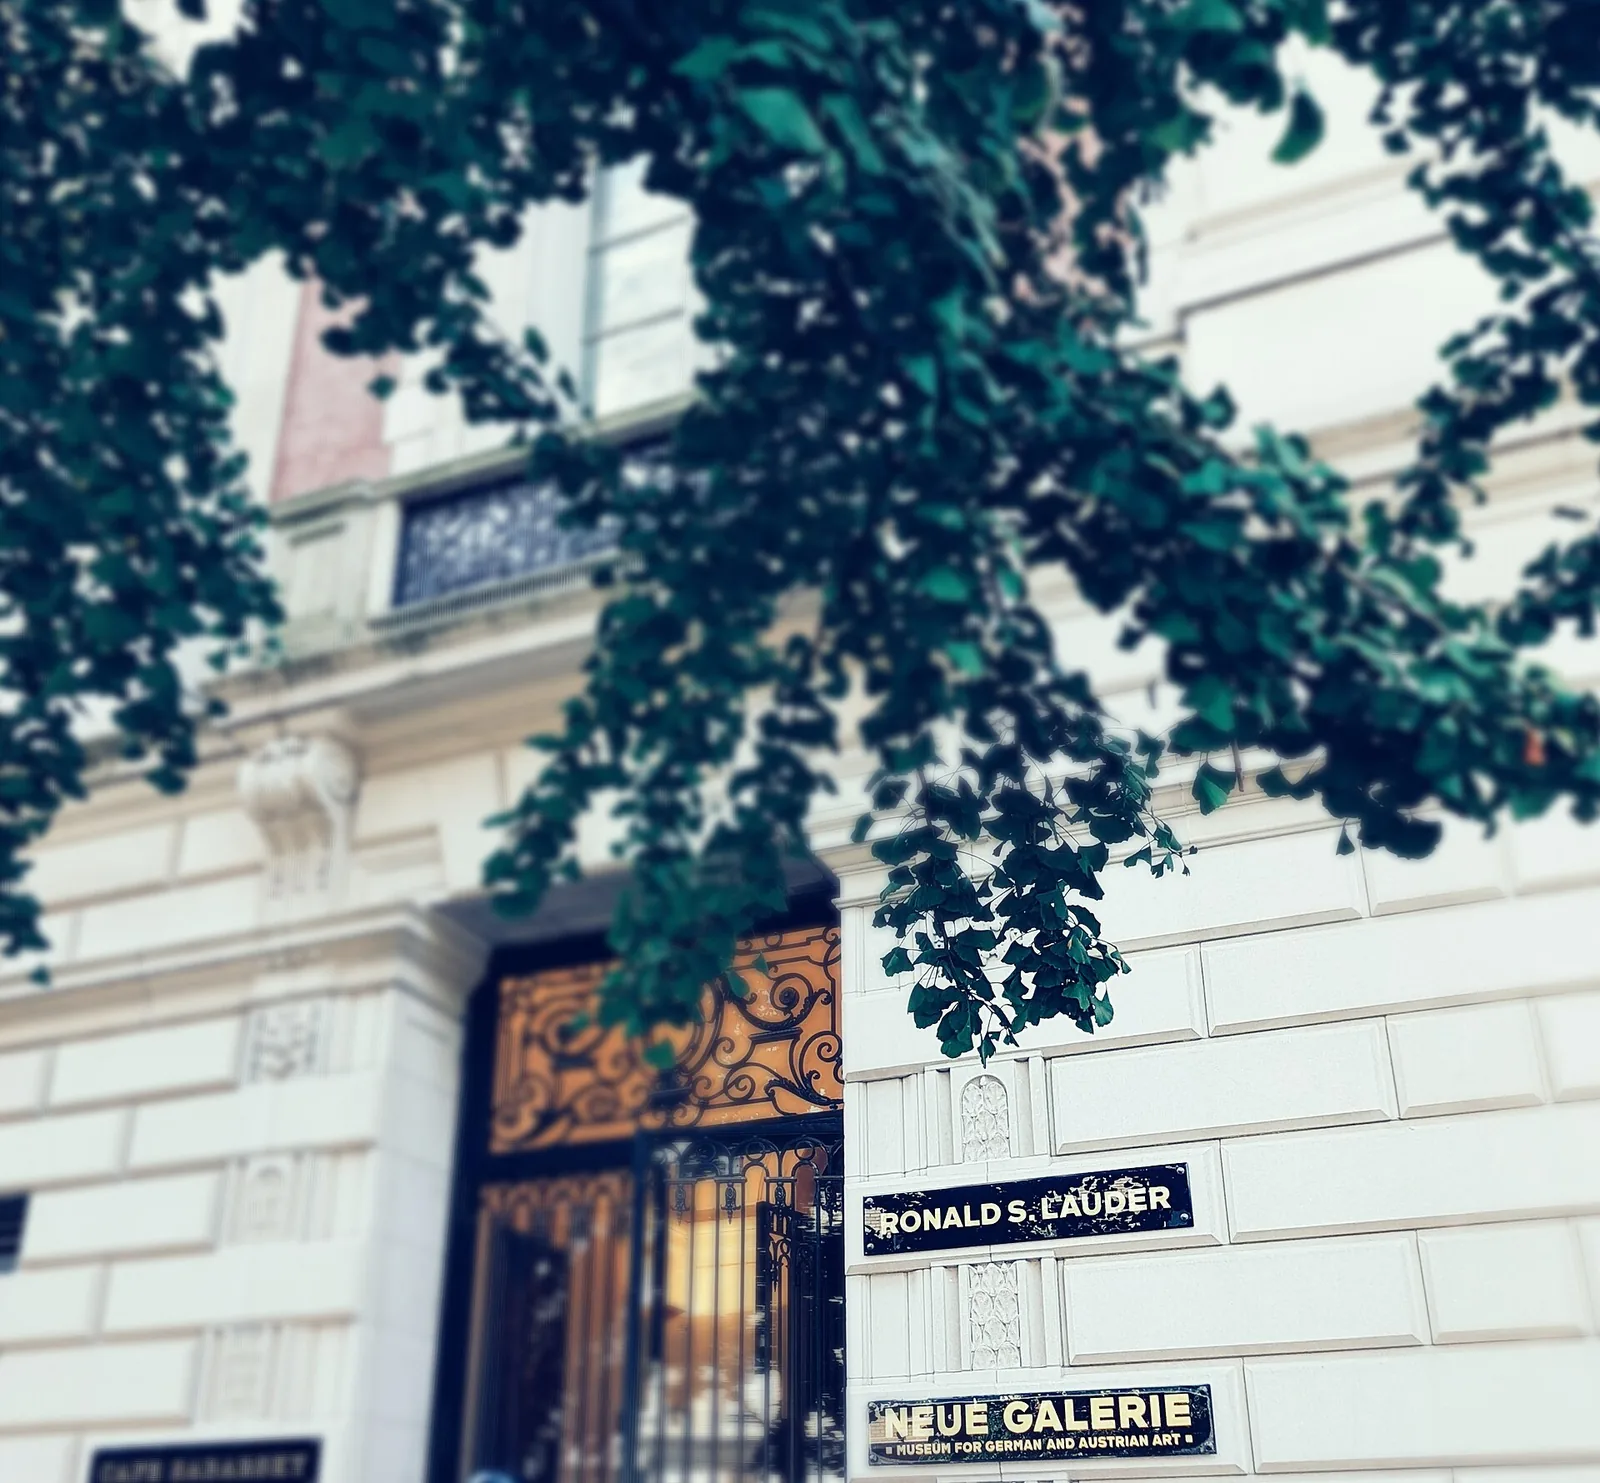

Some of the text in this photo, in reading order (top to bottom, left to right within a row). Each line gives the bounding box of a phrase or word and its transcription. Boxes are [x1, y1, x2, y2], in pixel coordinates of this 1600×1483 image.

[880, 1186, 1171, 1235] RONALD S. LAUDER
[884, 1393, 1192, 1438] NEUE GALERIE
[896, 1432, 1181, 1456] MUSEUM FOR GERMAN AND AUSTRIAN ART
